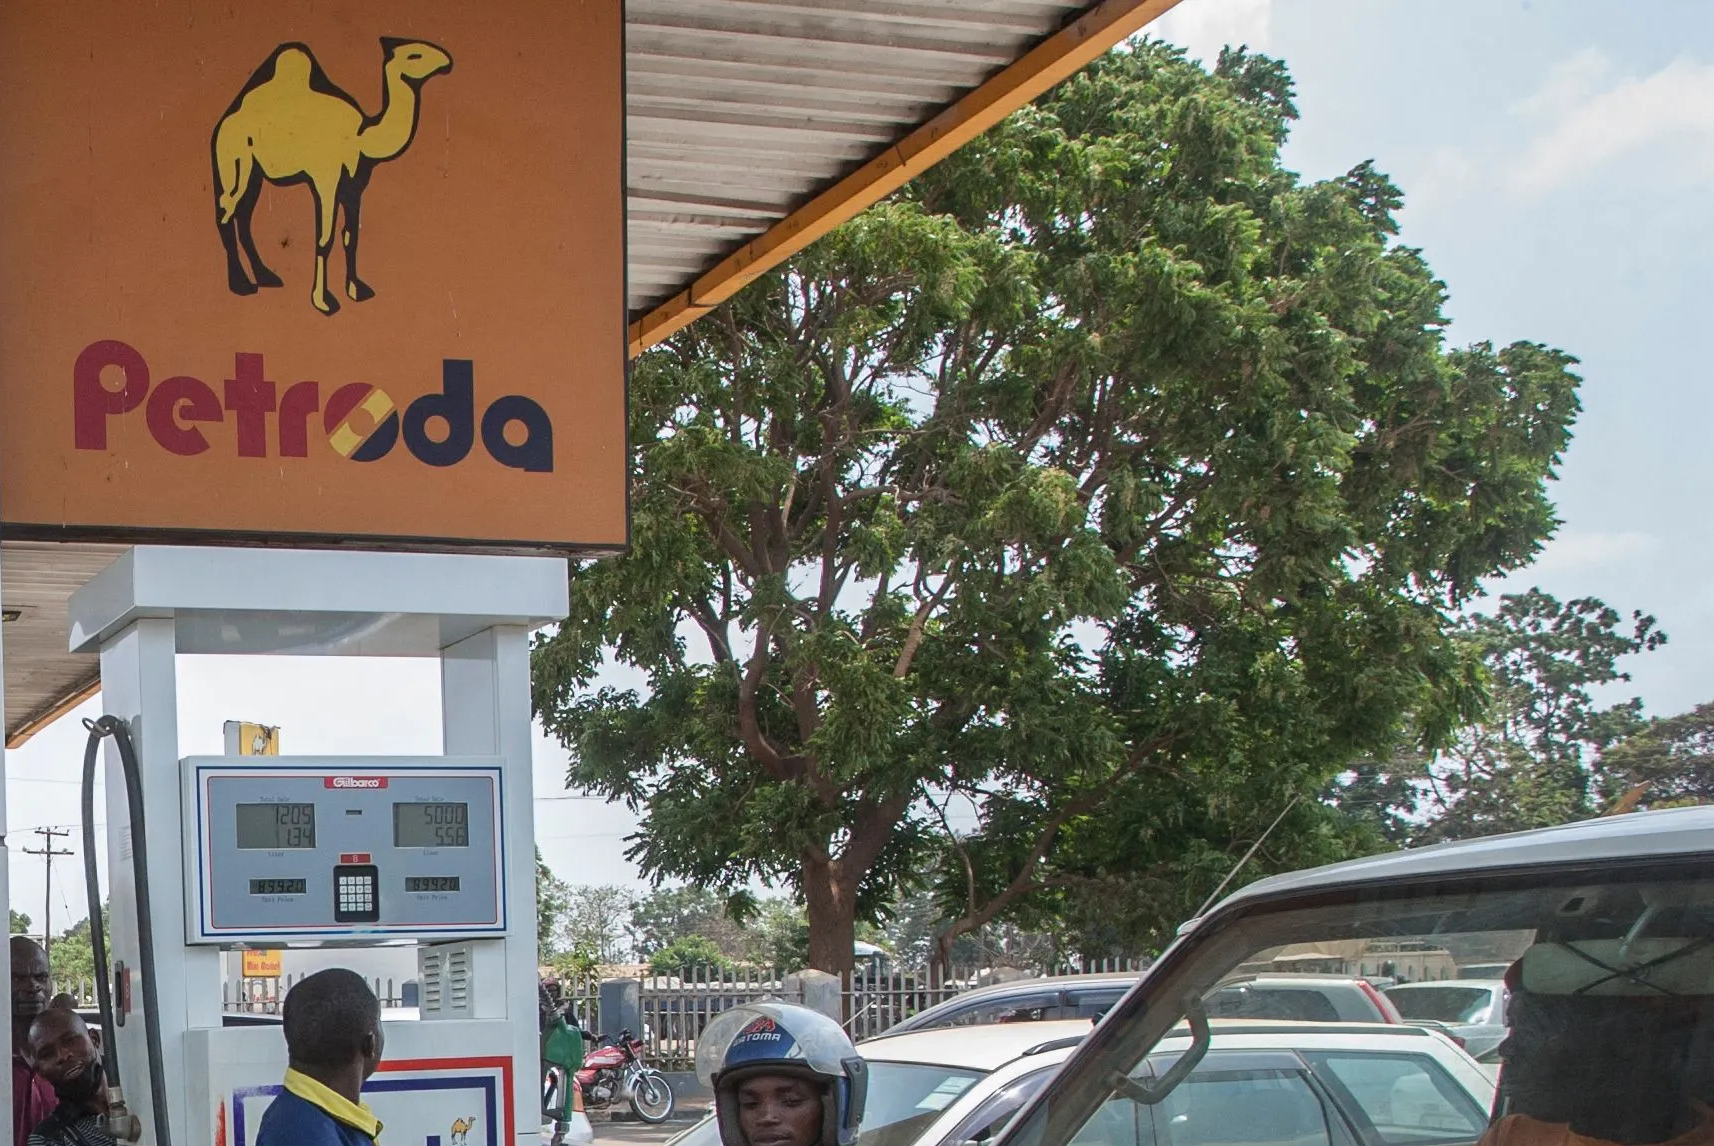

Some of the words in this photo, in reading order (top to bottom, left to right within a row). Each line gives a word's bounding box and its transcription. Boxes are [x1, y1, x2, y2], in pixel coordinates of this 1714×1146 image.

[73, 339, 554, 473] Petroda
[333, 776, 380, 788] Gilbarco
[276, 805, 311, 825] 1205
[424, 805, 464, 825] 5000
